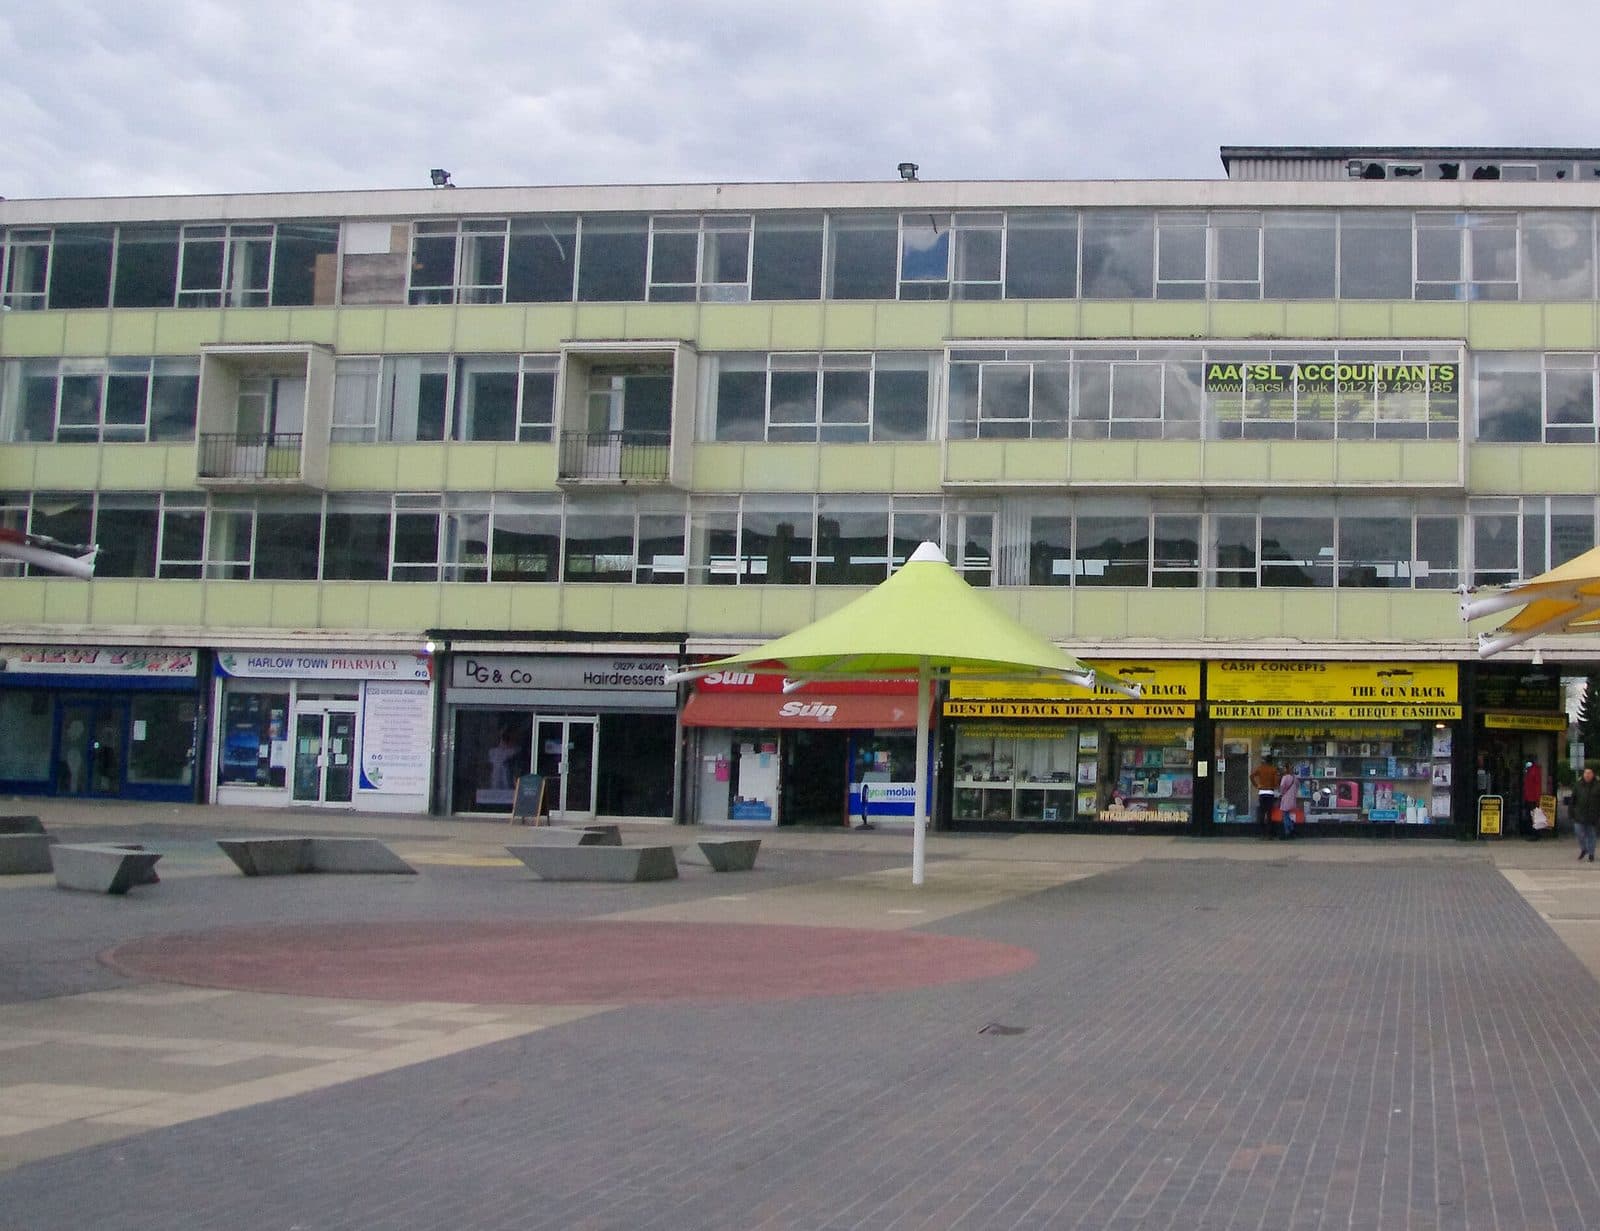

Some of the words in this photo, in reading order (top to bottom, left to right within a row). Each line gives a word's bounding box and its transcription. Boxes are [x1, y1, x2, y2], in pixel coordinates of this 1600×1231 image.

[1208, 364, 1283, 381] AACSL
[1289, 364, 1455, 381] ACCOUNTANTS
[1208, 381, 1328, 393] wwwaacsl.co.uk
[248, 657, 293, 668] HARLOW
[297, 658, 328, 669] TOWN
[331, 658, 398, 670] PHARMACY
[1220, 662, 1255, 672] CASH
[1261, 662, 1327, 672] CONCEPTS
[492, 669, 503, 684] &
[510, 669, 532, 684] Co
[583, 671, 665, 686] Hairdressers
[704, 671, 756, 685] Sun
[1151, 685, 1187, 695] RACK
[1350, 686, 1376, 697] THE
[1381, 686, 1407, 697] GUN
[1411, 687, 1446, 697] RACK
[949, 703, 986, 714] BEST
[990, 703, 1060, 715] BUYBACK
[1066, 703, 1113, 715] DEALS
[1119, 704, 1134, 715] IN
[1144, 704, 1186, 715] TOWN
[1216, 707, 1264, 717] BUREAU
[1268, 707, 1282, 717] DE
[1286, 707, 1336, 717] CHANGE
[1349, 707, 1397, 718] CHEQUE
[869, 786, 917, 798] ycamobil
